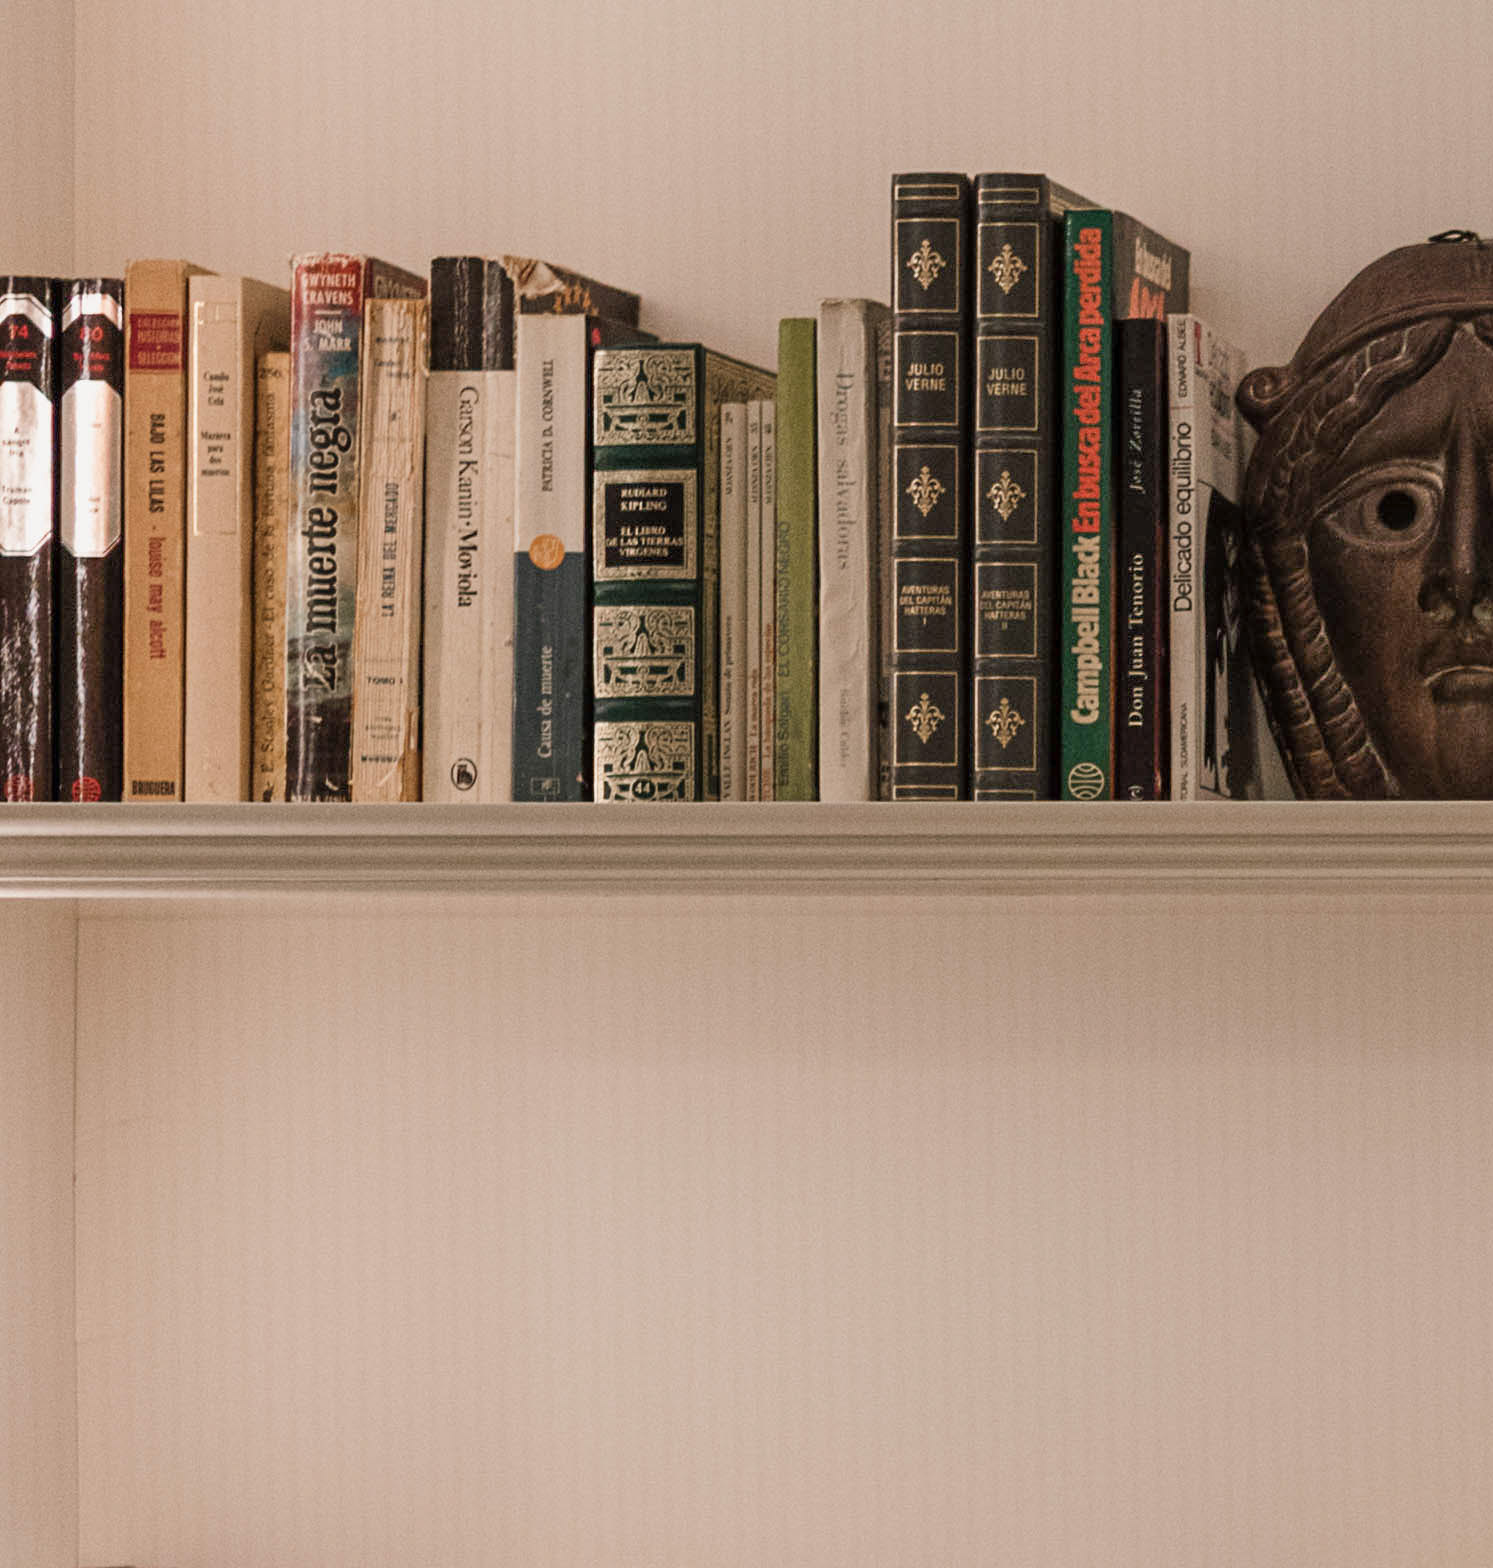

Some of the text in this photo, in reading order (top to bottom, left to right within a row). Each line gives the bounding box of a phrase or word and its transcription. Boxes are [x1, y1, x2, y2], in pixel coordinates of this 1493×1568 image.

[906, 377, 946, 392] VERNE
[907, 362, 945, 378] JULIO
[1072, 228, 1104, 533] En busca del Arca perdida
[302, 388, 352, 693] La muerte negra
[1173, 422, 1194, 613] Delicado equilibrio
[1070, 535, 1103, 724] Campbell Black
[1128, 552, 1148, 728] Don Juan Tenorio
